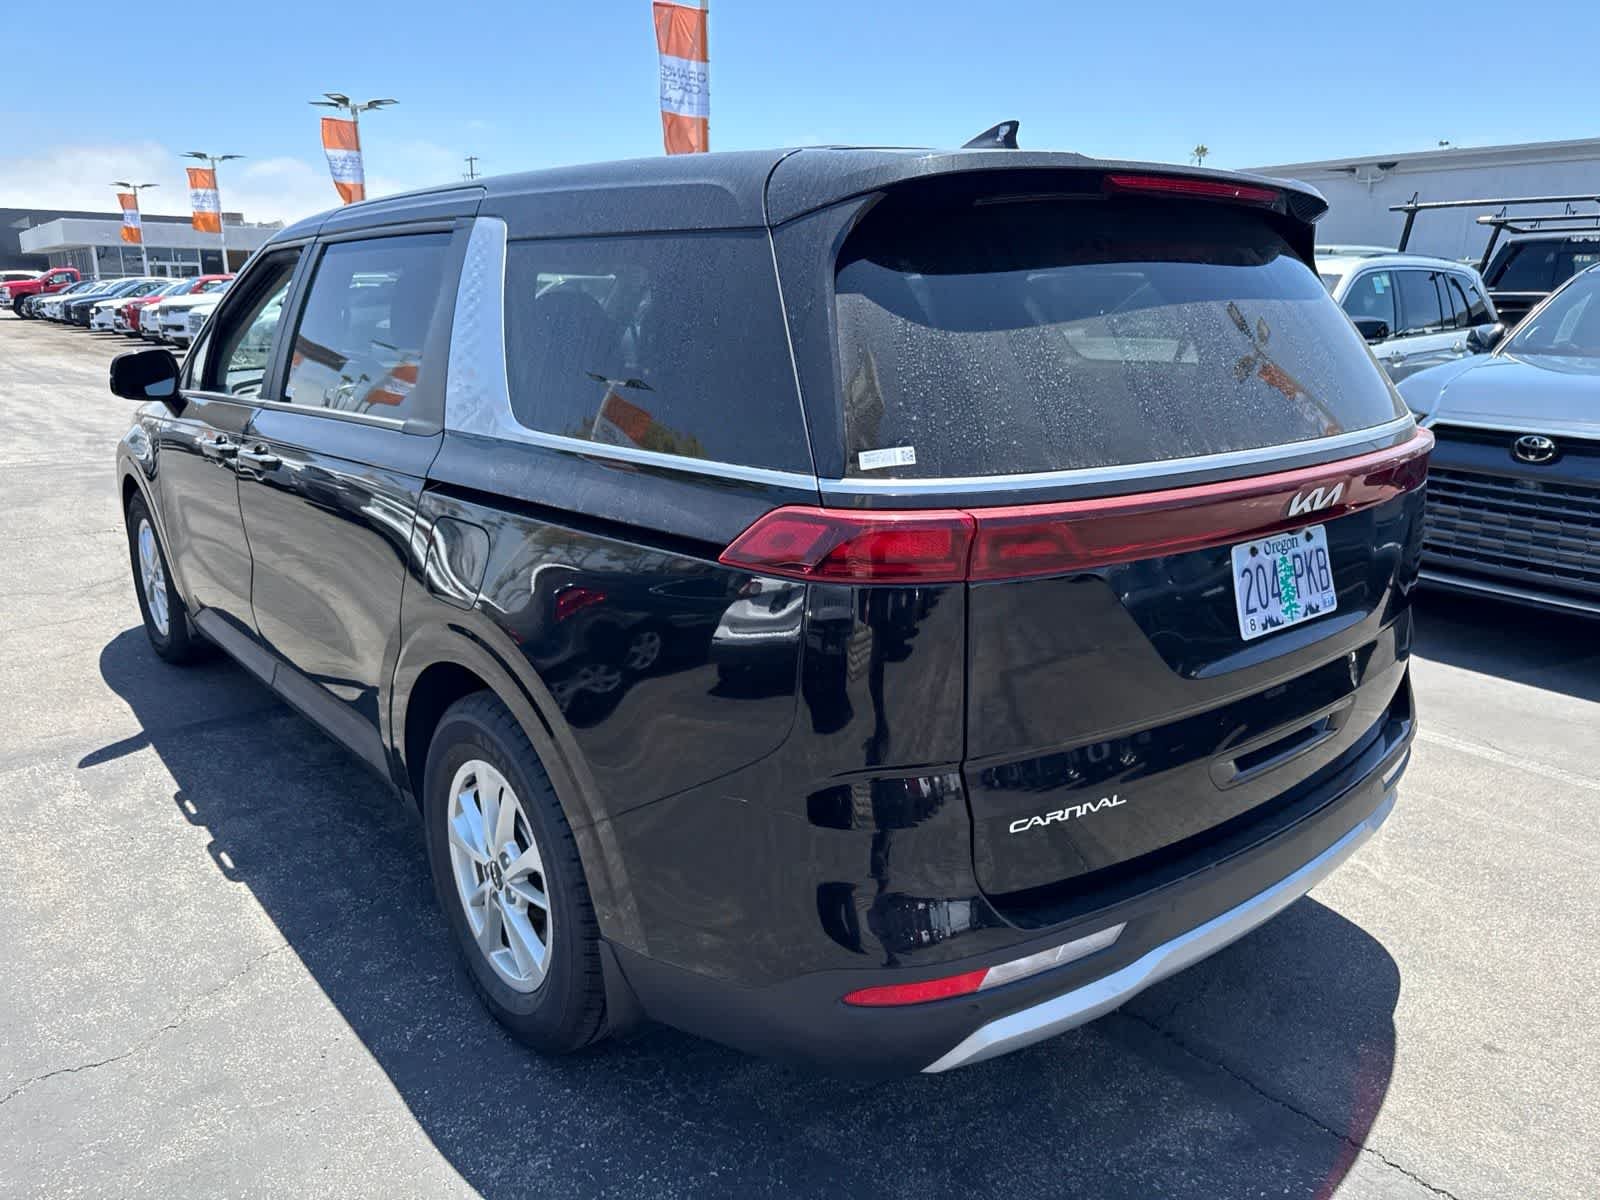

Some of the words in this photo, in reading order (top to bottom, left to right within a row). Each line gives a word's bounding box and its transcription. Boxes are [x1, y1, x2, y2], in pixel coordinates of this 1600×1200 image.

[1288, 482, 1344, 517] KIA
[1263, 537, 1299, 556] Oregon
[1241, 559, 1282, 616] 204
[1292, 547, 1330, 599] PKB
[1249, 618, 1257, 632] 8
[1009, 794, 1128, 834] CARNIVAL
